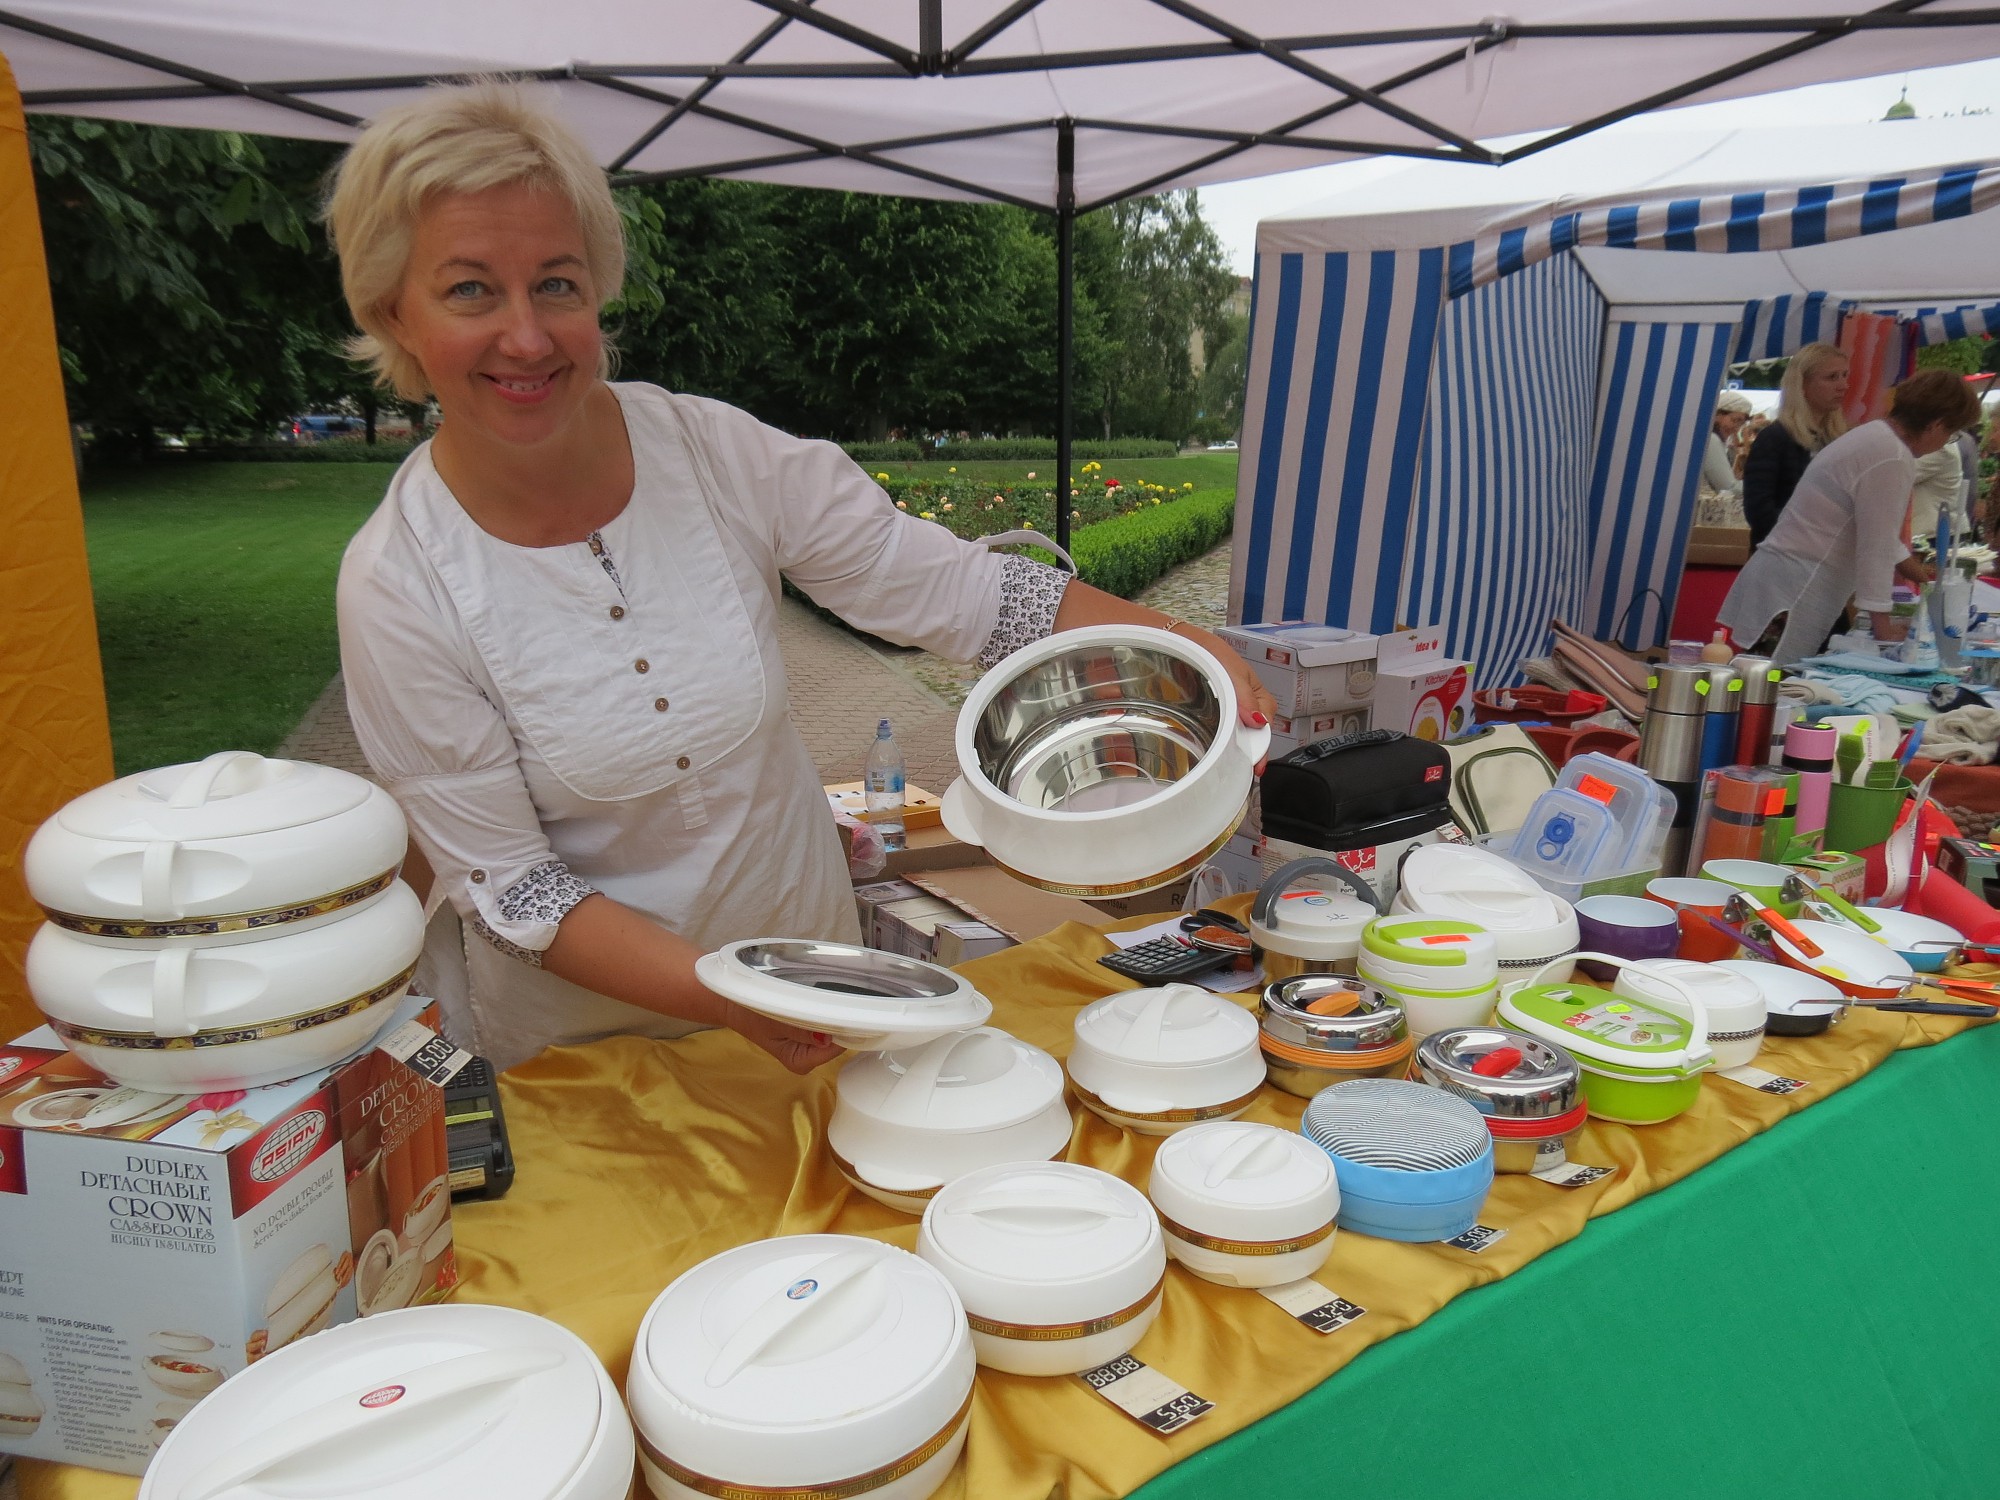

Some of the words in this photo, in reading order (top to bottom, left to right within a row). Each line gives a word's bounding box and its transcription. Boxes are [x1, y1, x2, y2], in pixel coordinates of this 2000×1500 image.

[1425, 674, 1448, 687] Kitchen
[1320, 732, 1358, 751] POLAR
[415, 1038, 454, 1070] 15.00
[261, 1121, 317, 1170] ASIAN
[126, 1156, 209, 1181] DUPLEX
[81, 1171, 211, 1201] DETACHABLE
[268, 1195, 300, 1227] DOUBLE
[301, 1168, 334, 1200] TROUBLE
[109, 1196, 213, 1226] CROWN
[110, 1218, 215, 1240] CASSEROLES
[111, 1233, 152, 1247] HIGHLY
[155, 1239, 217, 1254] INSULATED
[1313, 1301, 1352, 1318] 4.20
[37, 1315, 56, 1325] HINTS
[58, 1318, 72, 1327] FOR
[73, 1320, 115, 1334] OPERATING:
[1157, 1395, 1201, 1420] 5.60
